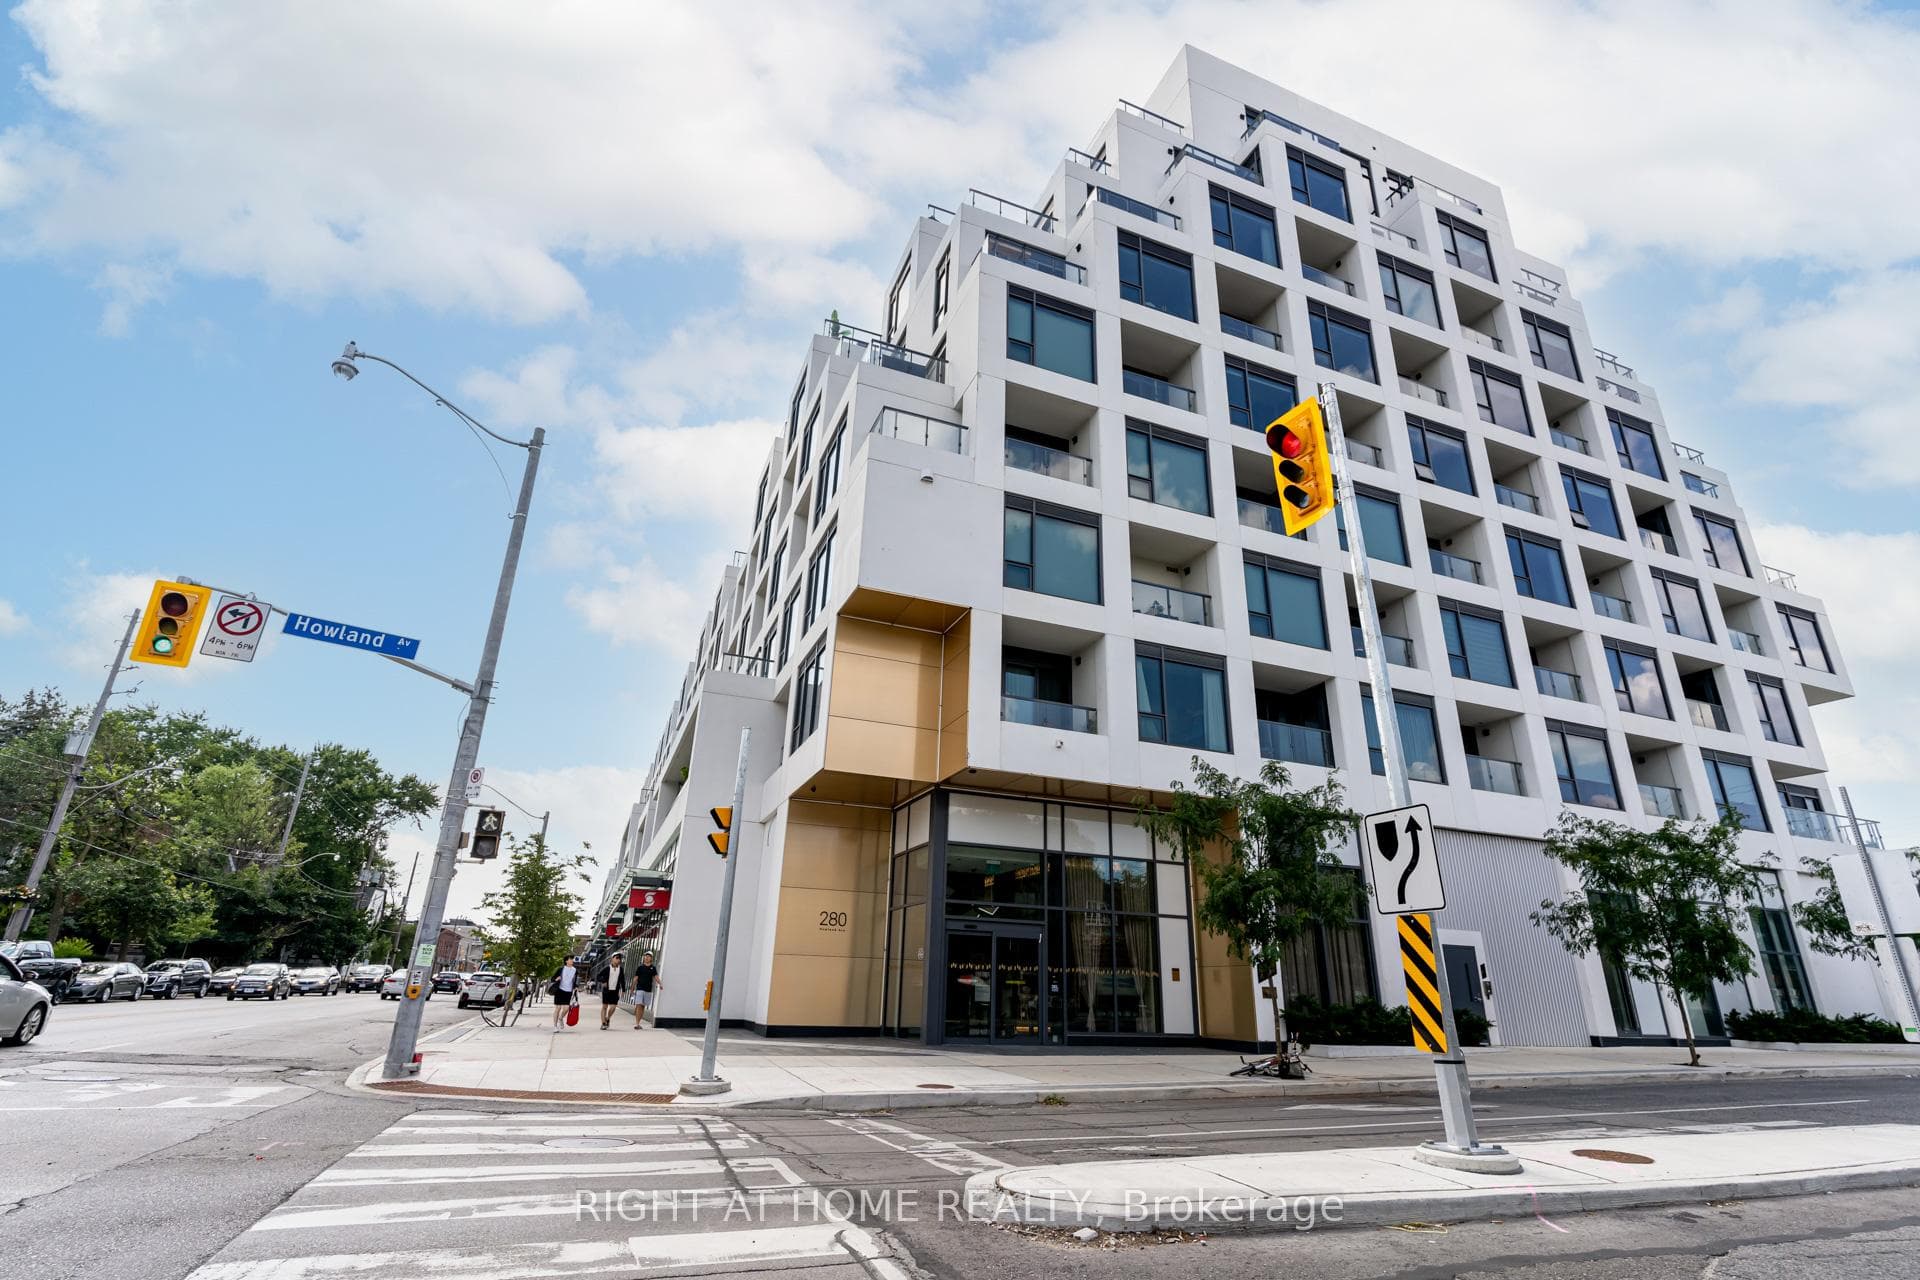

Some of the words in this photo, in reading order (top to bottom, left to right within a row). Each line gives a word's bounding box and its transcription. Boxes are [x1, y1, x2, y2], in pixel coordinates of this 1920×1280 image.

[294, 615, 386, 648] Howland
[397, 637, 411, 647] Av
[819, 910, 847, 927] 280
